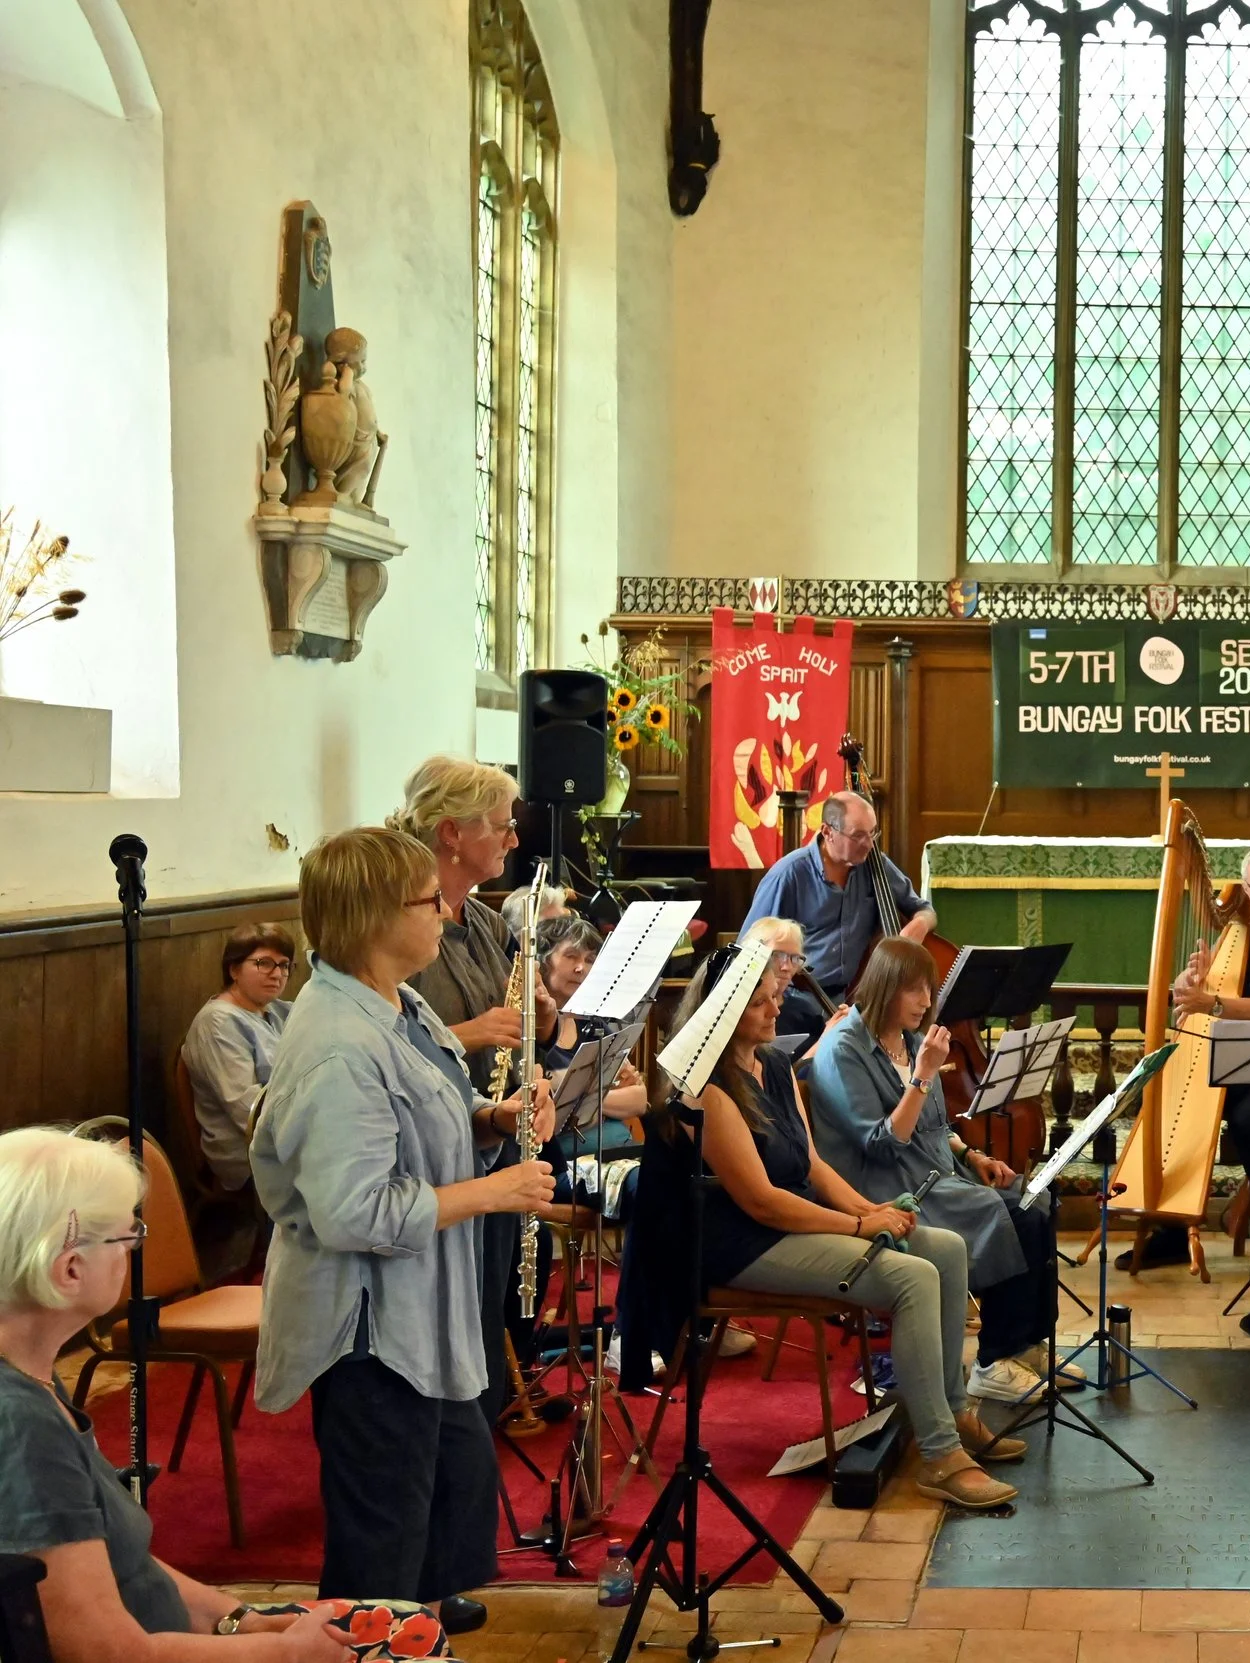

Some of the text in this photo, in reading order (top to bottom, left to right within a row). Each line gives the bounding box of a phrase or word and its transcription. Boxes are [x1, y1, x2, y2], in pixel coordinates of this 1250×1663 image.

[728, 643, 838, 677] COME HOLY
[1029, 651, 1116, 684] 5-7TH
[1018, 705, 1122, 734] BUNGAY
[1134, 705, 1192, 734] FOLK
[1113, 754, 1212, 765] bungayfolkftival.co.uk
